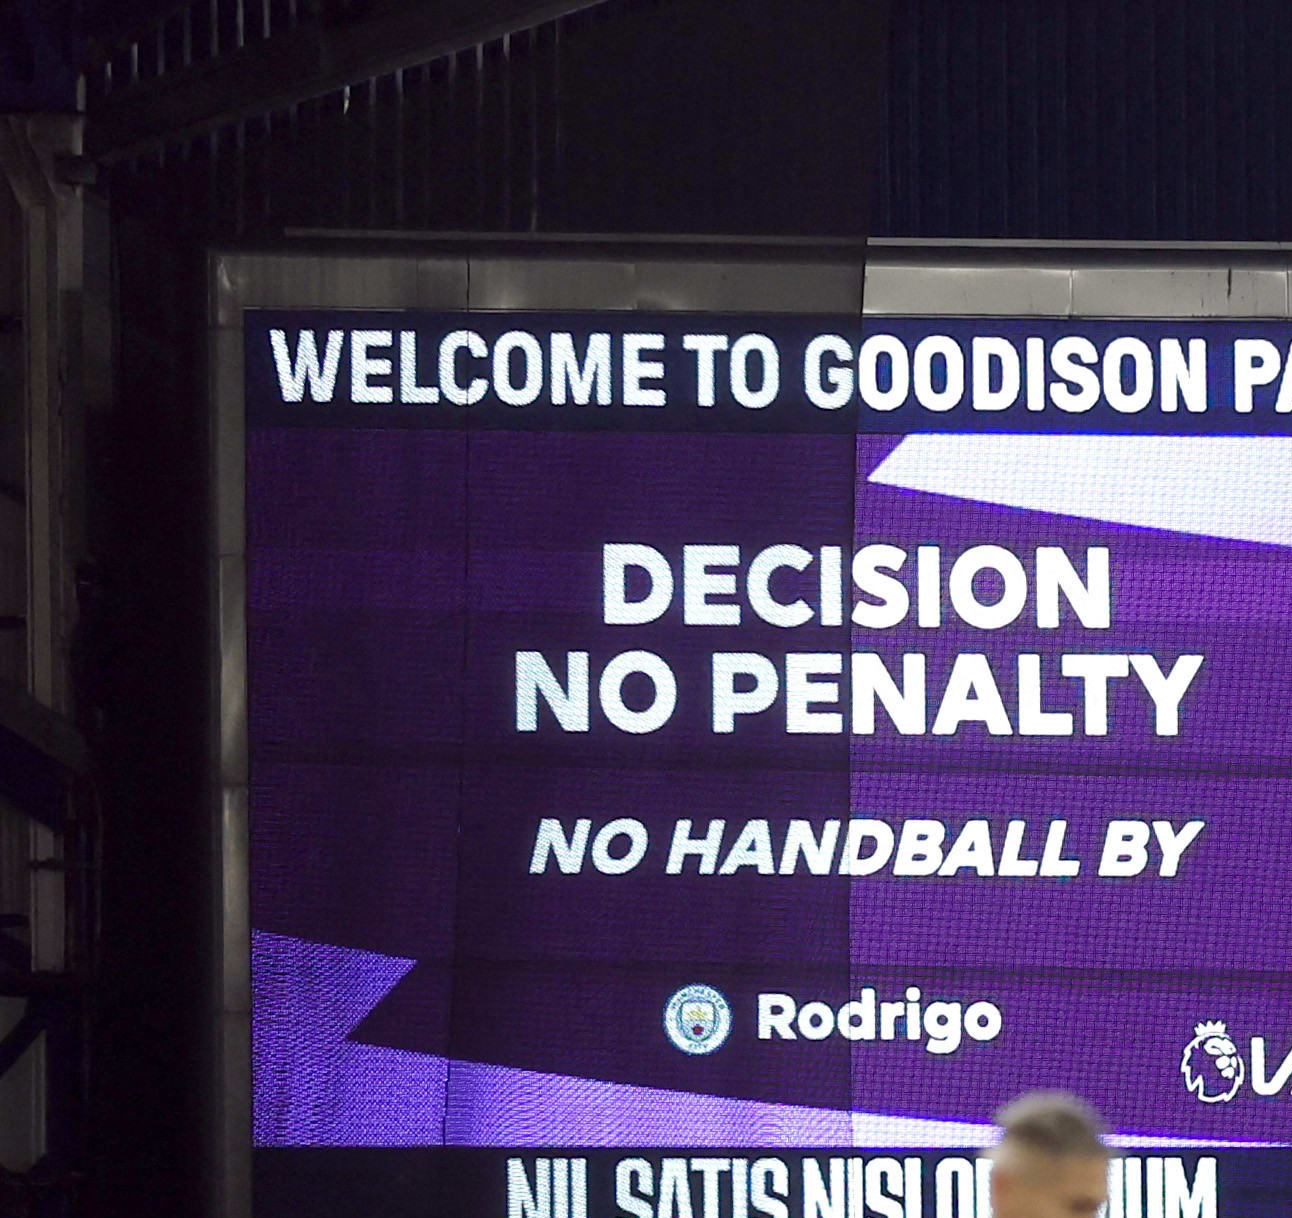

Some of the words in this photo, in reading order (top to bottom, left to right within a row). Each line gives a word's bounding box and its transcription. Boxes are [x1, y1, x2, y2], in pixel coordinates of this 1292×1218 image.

[269, 328, 666, 406] WELCOME
[683, 333, 780, 409] TO
[803, 334, 1207, 413] GOODISON
[602, 543, 1112, 630] DECISION
[515, 650, 678, 734] NO
[712, 652, 1205, 736] PENALTY
[529, 818, 648, 875] NO
[666, 819, 1081, 878] HANDBALL
[1098, 819, 1206, 878] BY
[757, 987, 1003, 1055] Rodrigo
